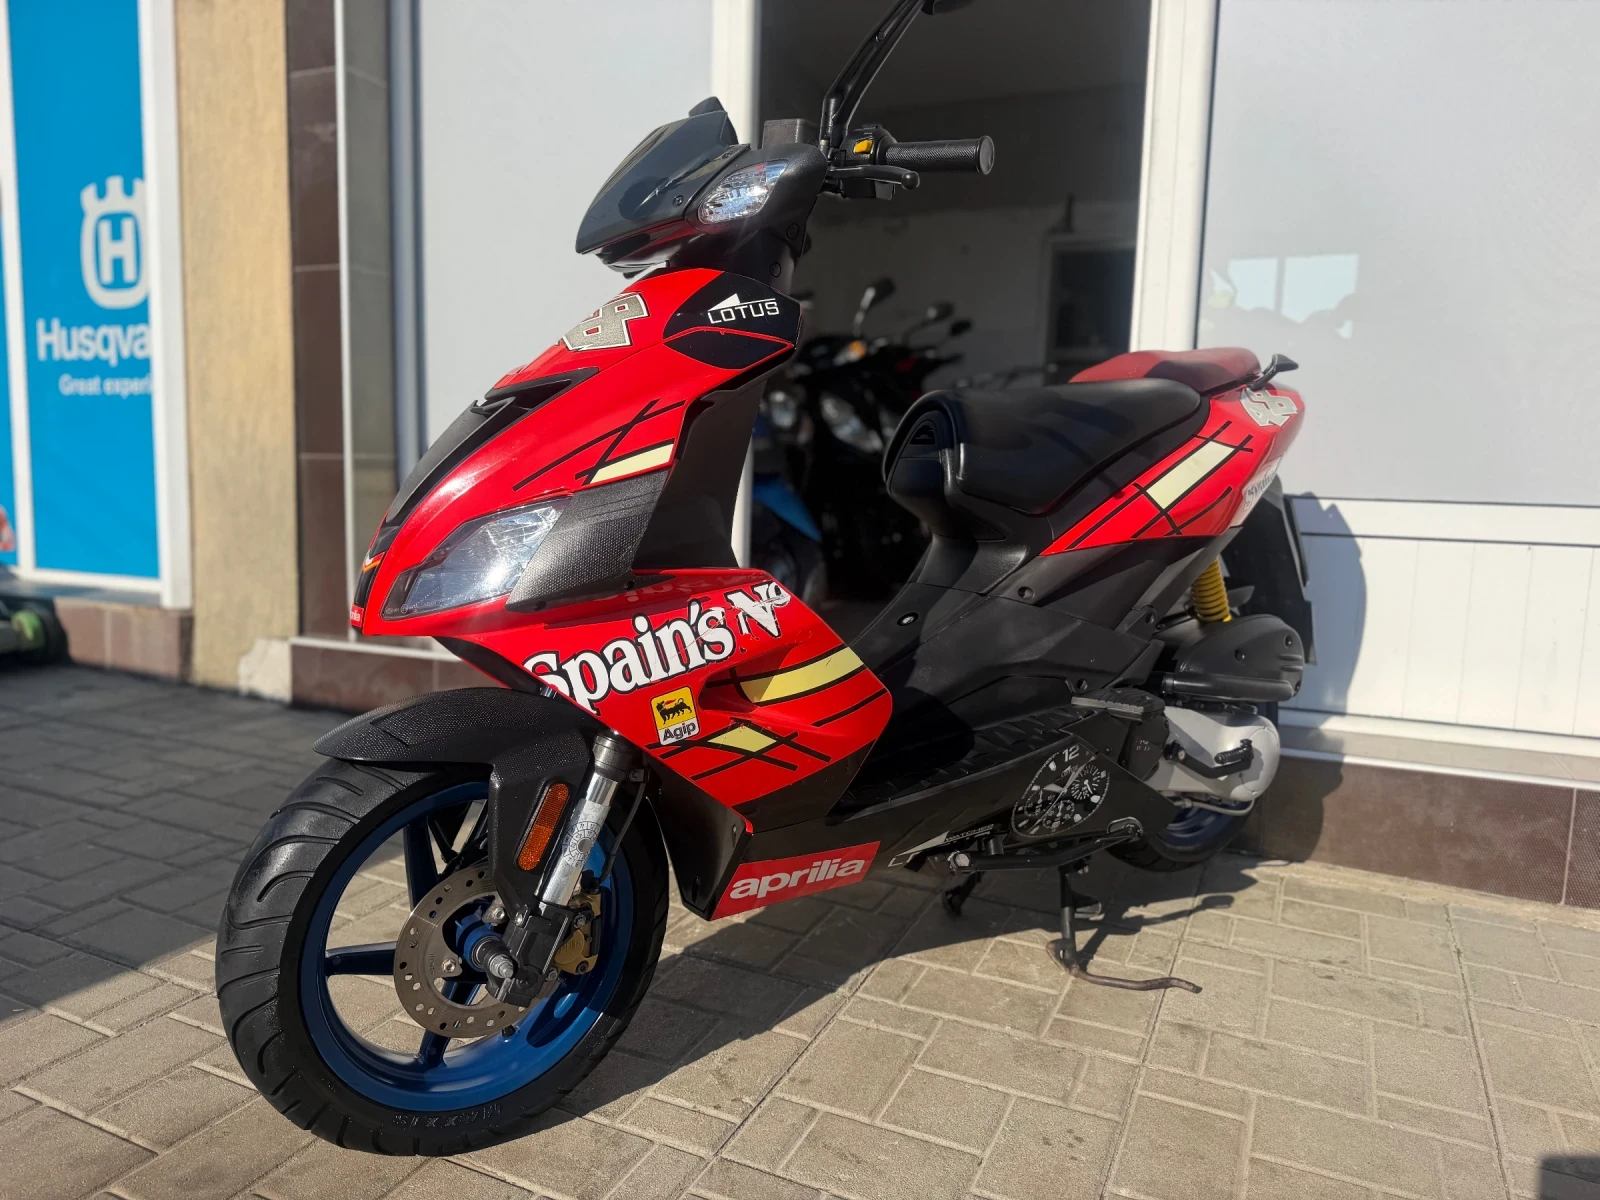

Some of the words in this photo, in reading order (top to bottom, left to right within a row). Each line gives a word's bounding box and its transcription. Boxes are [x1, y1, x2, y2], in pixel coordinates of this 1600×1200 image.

[707, 301, 780, 325] LOTUS
[36, 317, 150, 367] Husqva
[58, 374, 101, 396] Great
[521, 597, 736, 716] Spain's
[661, 722, 697, 741] Agip
[1062, 744, 1080, 763] 12
[729, 857, 865, 899] aprilia
